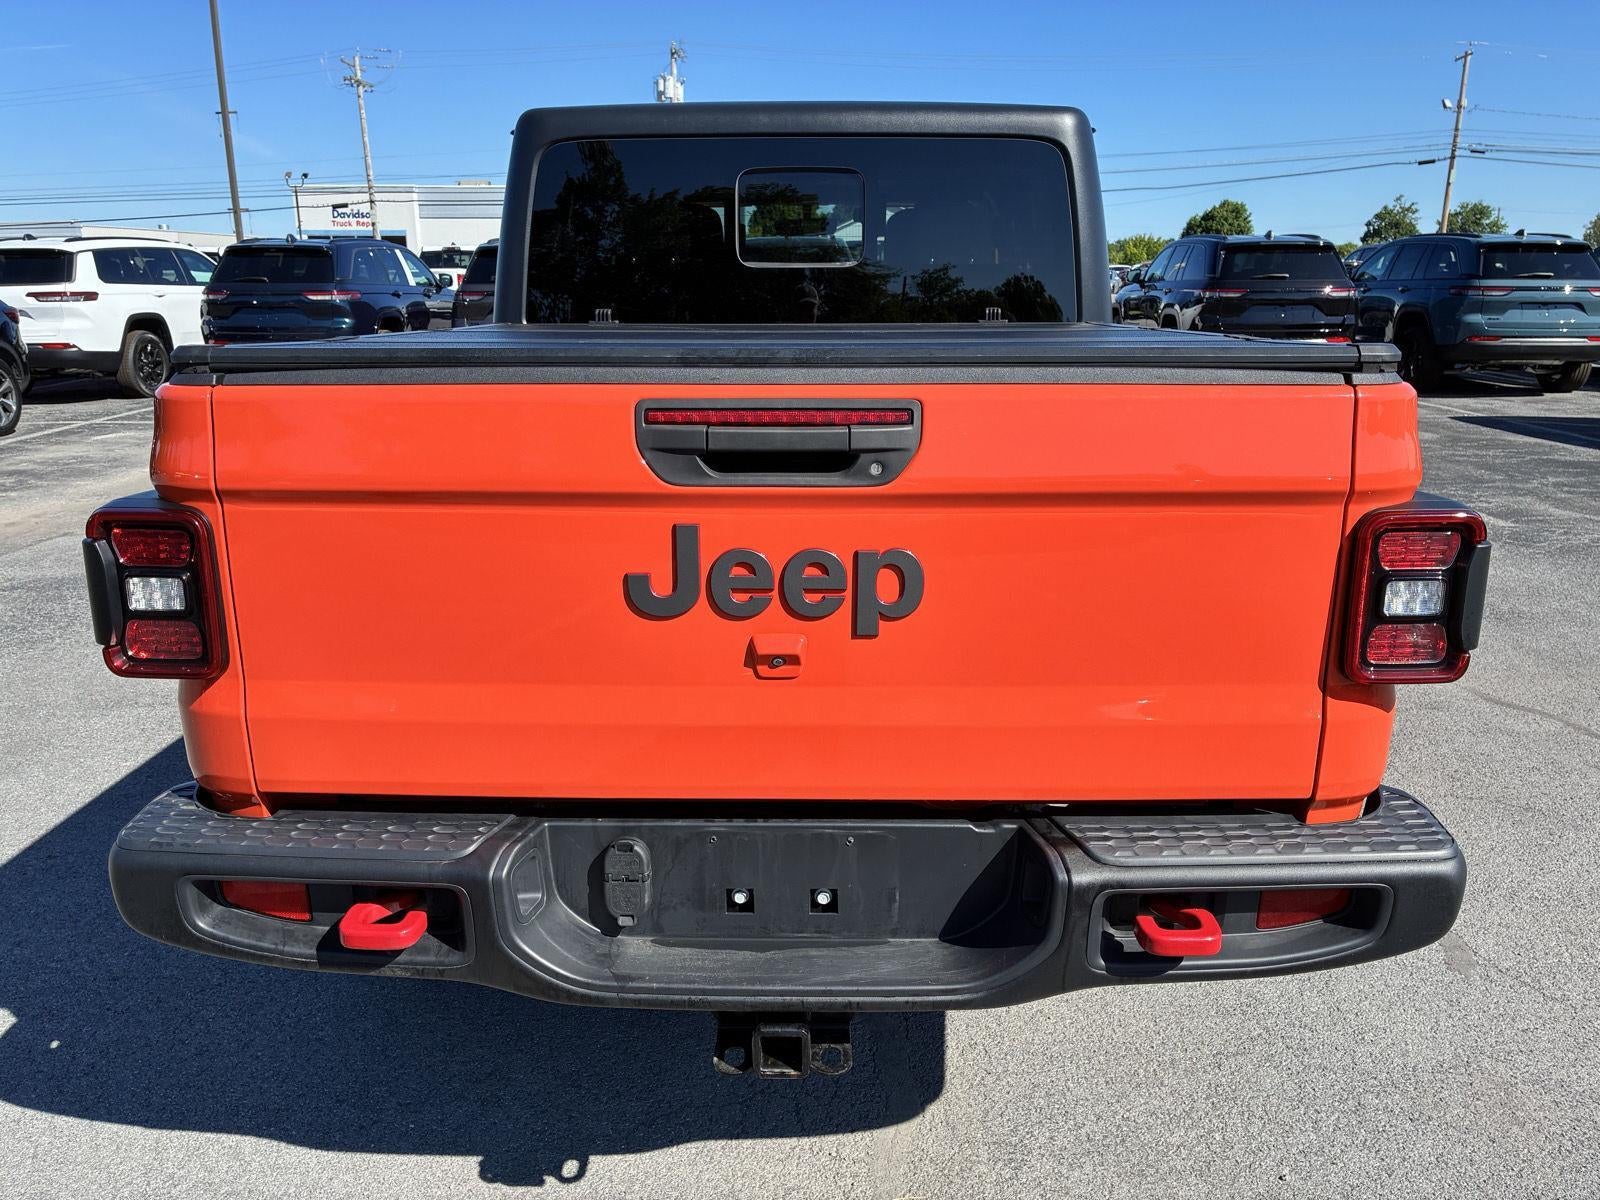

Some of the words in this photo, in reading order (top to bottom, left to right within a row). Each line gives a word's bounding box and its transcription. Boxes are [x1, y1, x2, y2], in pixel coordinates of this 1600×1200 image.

[332, 209, 371, 219] Davidso
[356, 220, 371, 228] Rep
[623, 524, 925, 640] Jeep
